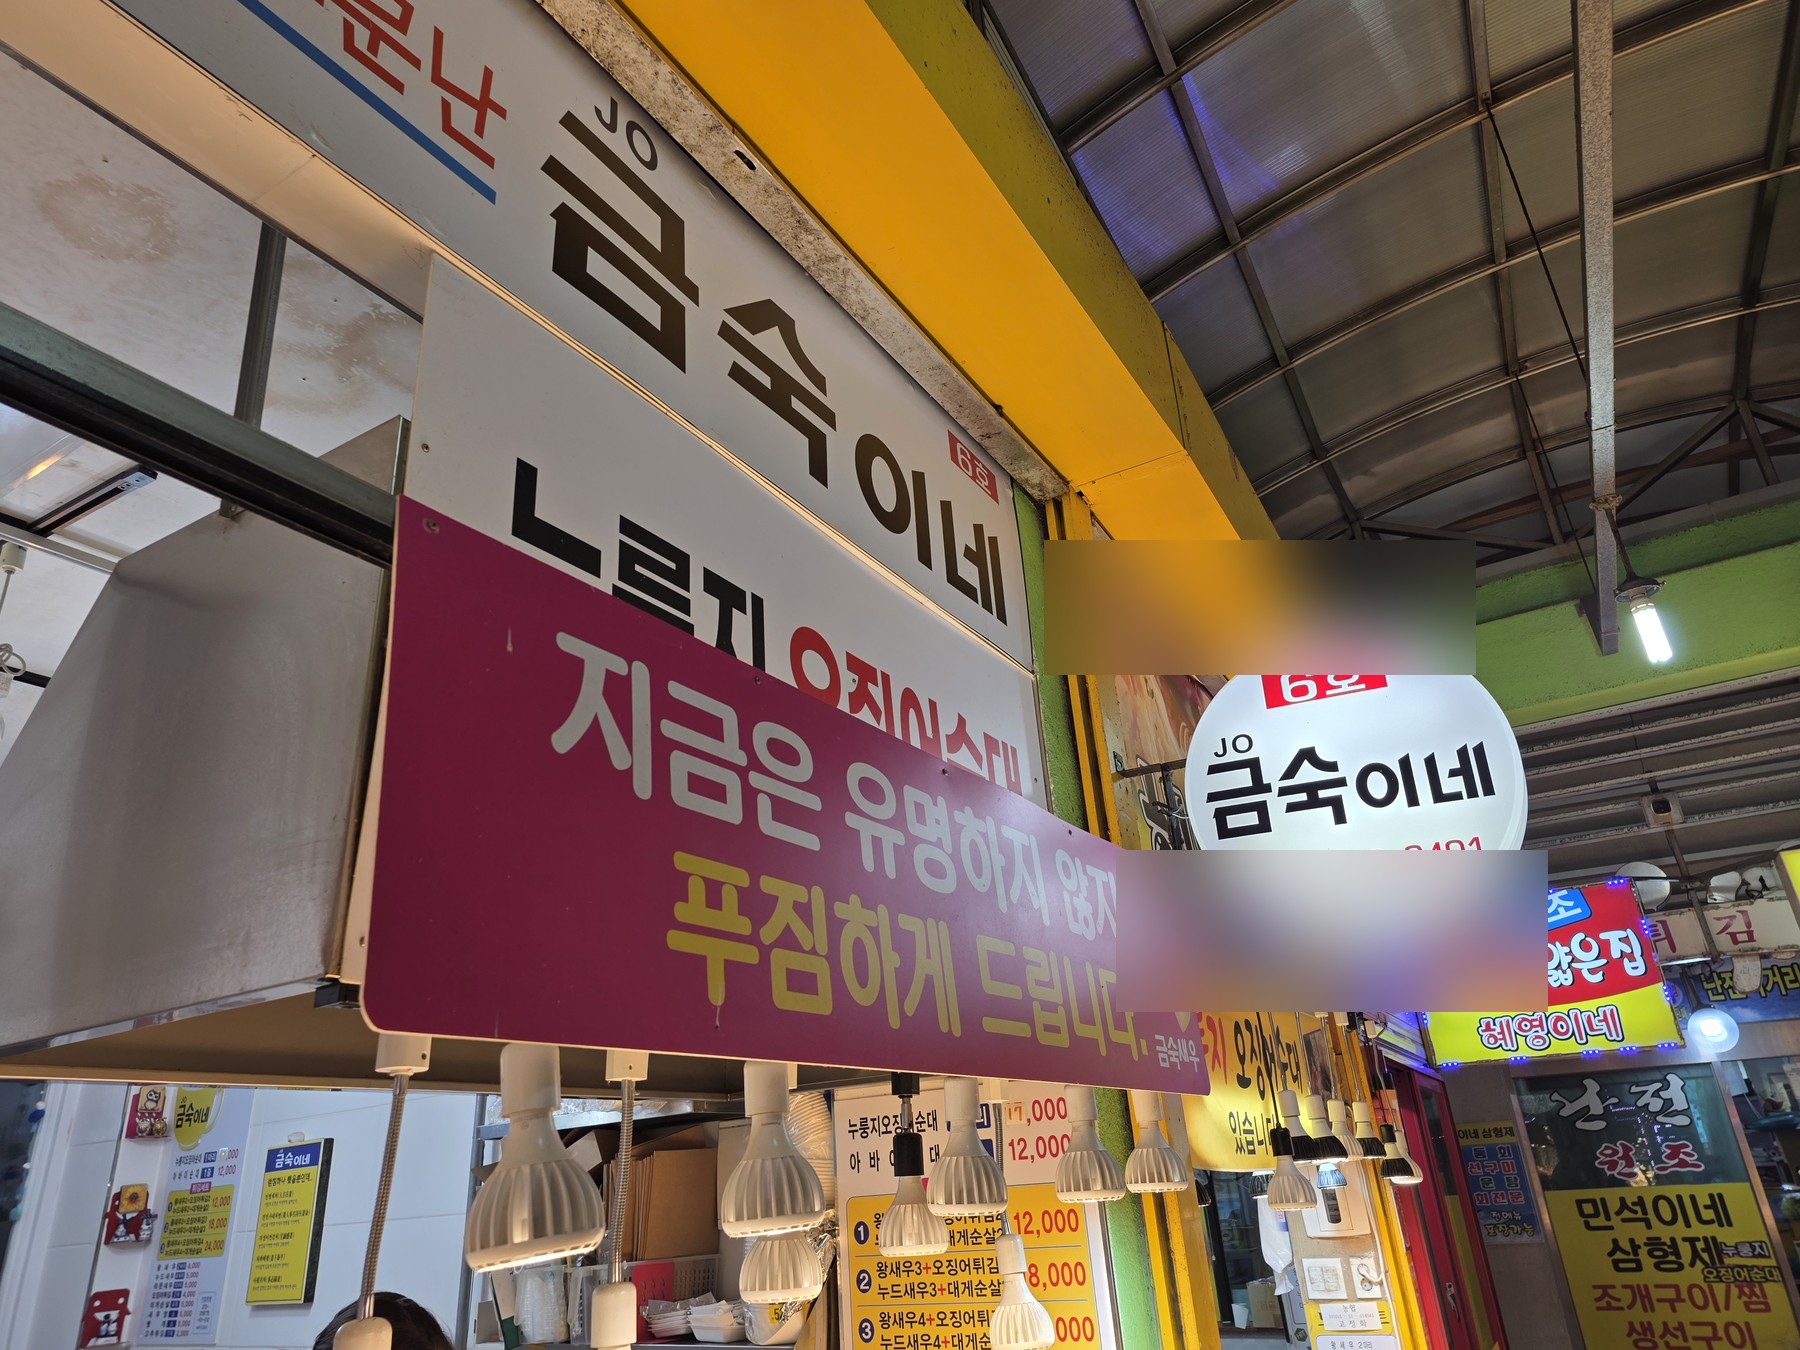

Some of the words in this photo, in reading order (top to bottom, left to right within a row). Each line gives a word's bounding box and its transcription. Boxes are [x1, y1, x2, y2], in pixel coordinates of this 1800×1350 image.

[314, 0, 507, 170] 문난
[593, 96, 658, 171] JO
[540, 110, 1008, 627] 금숙이네
[956, 440, 992, 496] 6호
[1213, 733, 1254, 758] JO
[551, 631, 822, 852] 지금은
[844, 761, 1051, 928] 유명하지
[1055, 849, 1117, 942] 않지
[1206, 740, 1496, 841] 금숙이네
[1548, 889, 1582, 923] 조
[666, 850, 962, 1038] 푸짐하게
[975, 935, 1149, 1062] 드립니다.
[1701, 962, 1800, 1002] 난전거리
[1478, 1006, 1624, 1051] 혜영이네
[1154, 1033, 1201, 1074] 금숙새우
[176, 1103, 210, 1128] 금숙이네
[1550, 1073, 1693, 1131] 난전
[848, 1109, 938, 1140] 누룽지오징순대
[1458, 1128, 1480, 1140] 이네
[1481, 1126, 1515, 1139] 삼형제
[217, 1164, 236, 1176] 12,000
[275, 1152, 311, 1169] 금숙이네
[1595, 1140, 1705, 1180] 원조
[212, 1196, 231, 1208] 12,000
[1575, 1192, 1734, 1231] 민석이네
[1013, 1208, 1079, 1237] 12,000
[1485, 1223, 1535, 1237] 포장가능
[204, 1240, 224, 1252] 24,000
[1606, 1235, 1725, 1273] 삼형제
[1721, 1242, 1770, 1258] 누룽지
[876, 1257, 999, 1279] 왕새우3+오징어튀김
[1028, 1261, 1086, 1291] 8,000
[1703, 1265, 1782, 1284] 오징어순대
[877, 1279, 1002, 1300] 누드새우3+대게순살
[1591, 1282, 1773, 1314] 조개구이/찜
[879, 1310, 994, 1330] 왕새우4+오징어튀
[1055, 1316, 1094, 1342] 000
[1625, 1320, 1758, 1350] 생선구이
